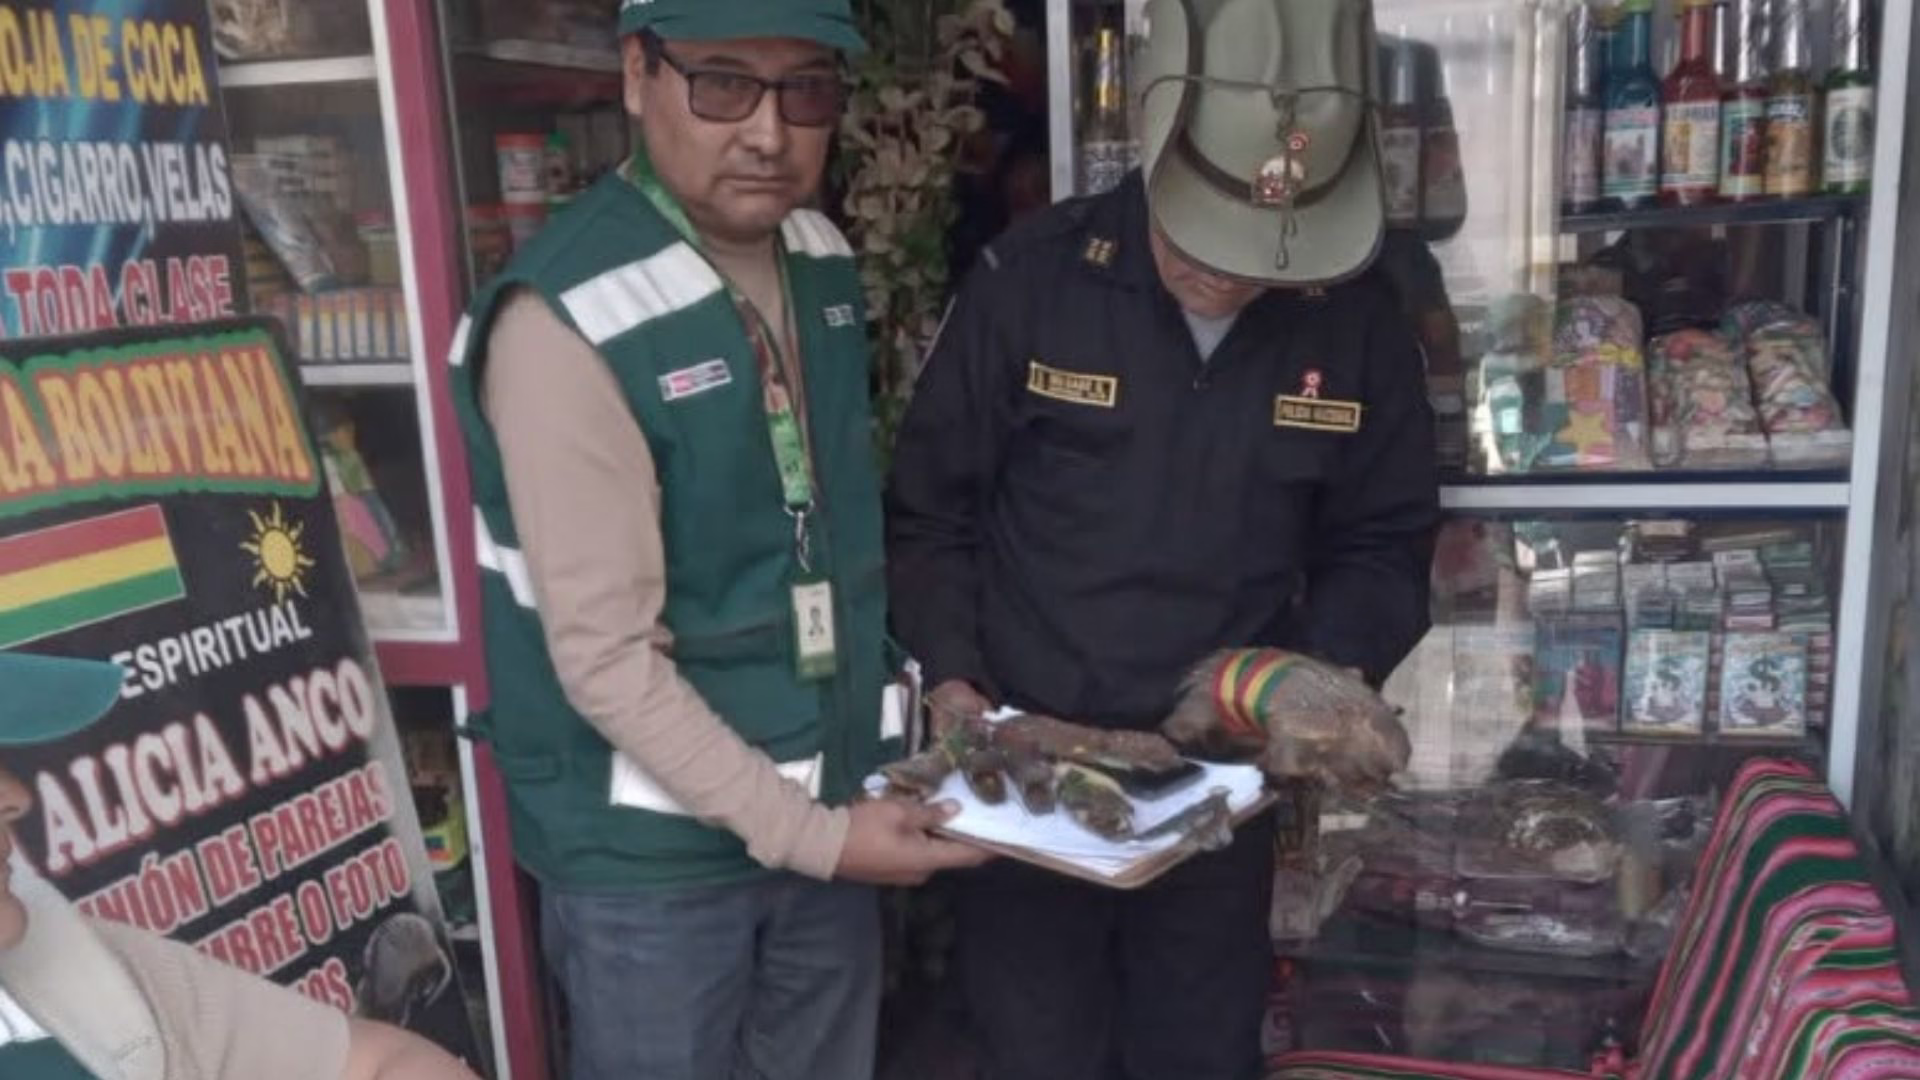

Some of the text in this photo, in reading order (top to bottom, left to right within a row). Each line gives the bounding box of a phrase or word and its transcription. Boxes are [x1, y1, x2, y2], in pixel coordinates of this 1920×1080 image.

[0, 4, 209, 106] OJA DE COCA
[4, 254, 235, 338] TODA CLASE
[35, 346, 314, 486] BOLIVIANA
[110, 600, 312, 699] ESPIRITUAL
[36, 654, 378, 873] ALICIA ANCO
[197, 823, 262, 907] DE
[249, 759, 395, 880] PAREJAS
[297, 880, 333, 946] O
[324, 836, 410, 931] FOTO
[297, 956, 356, 1016] OS
